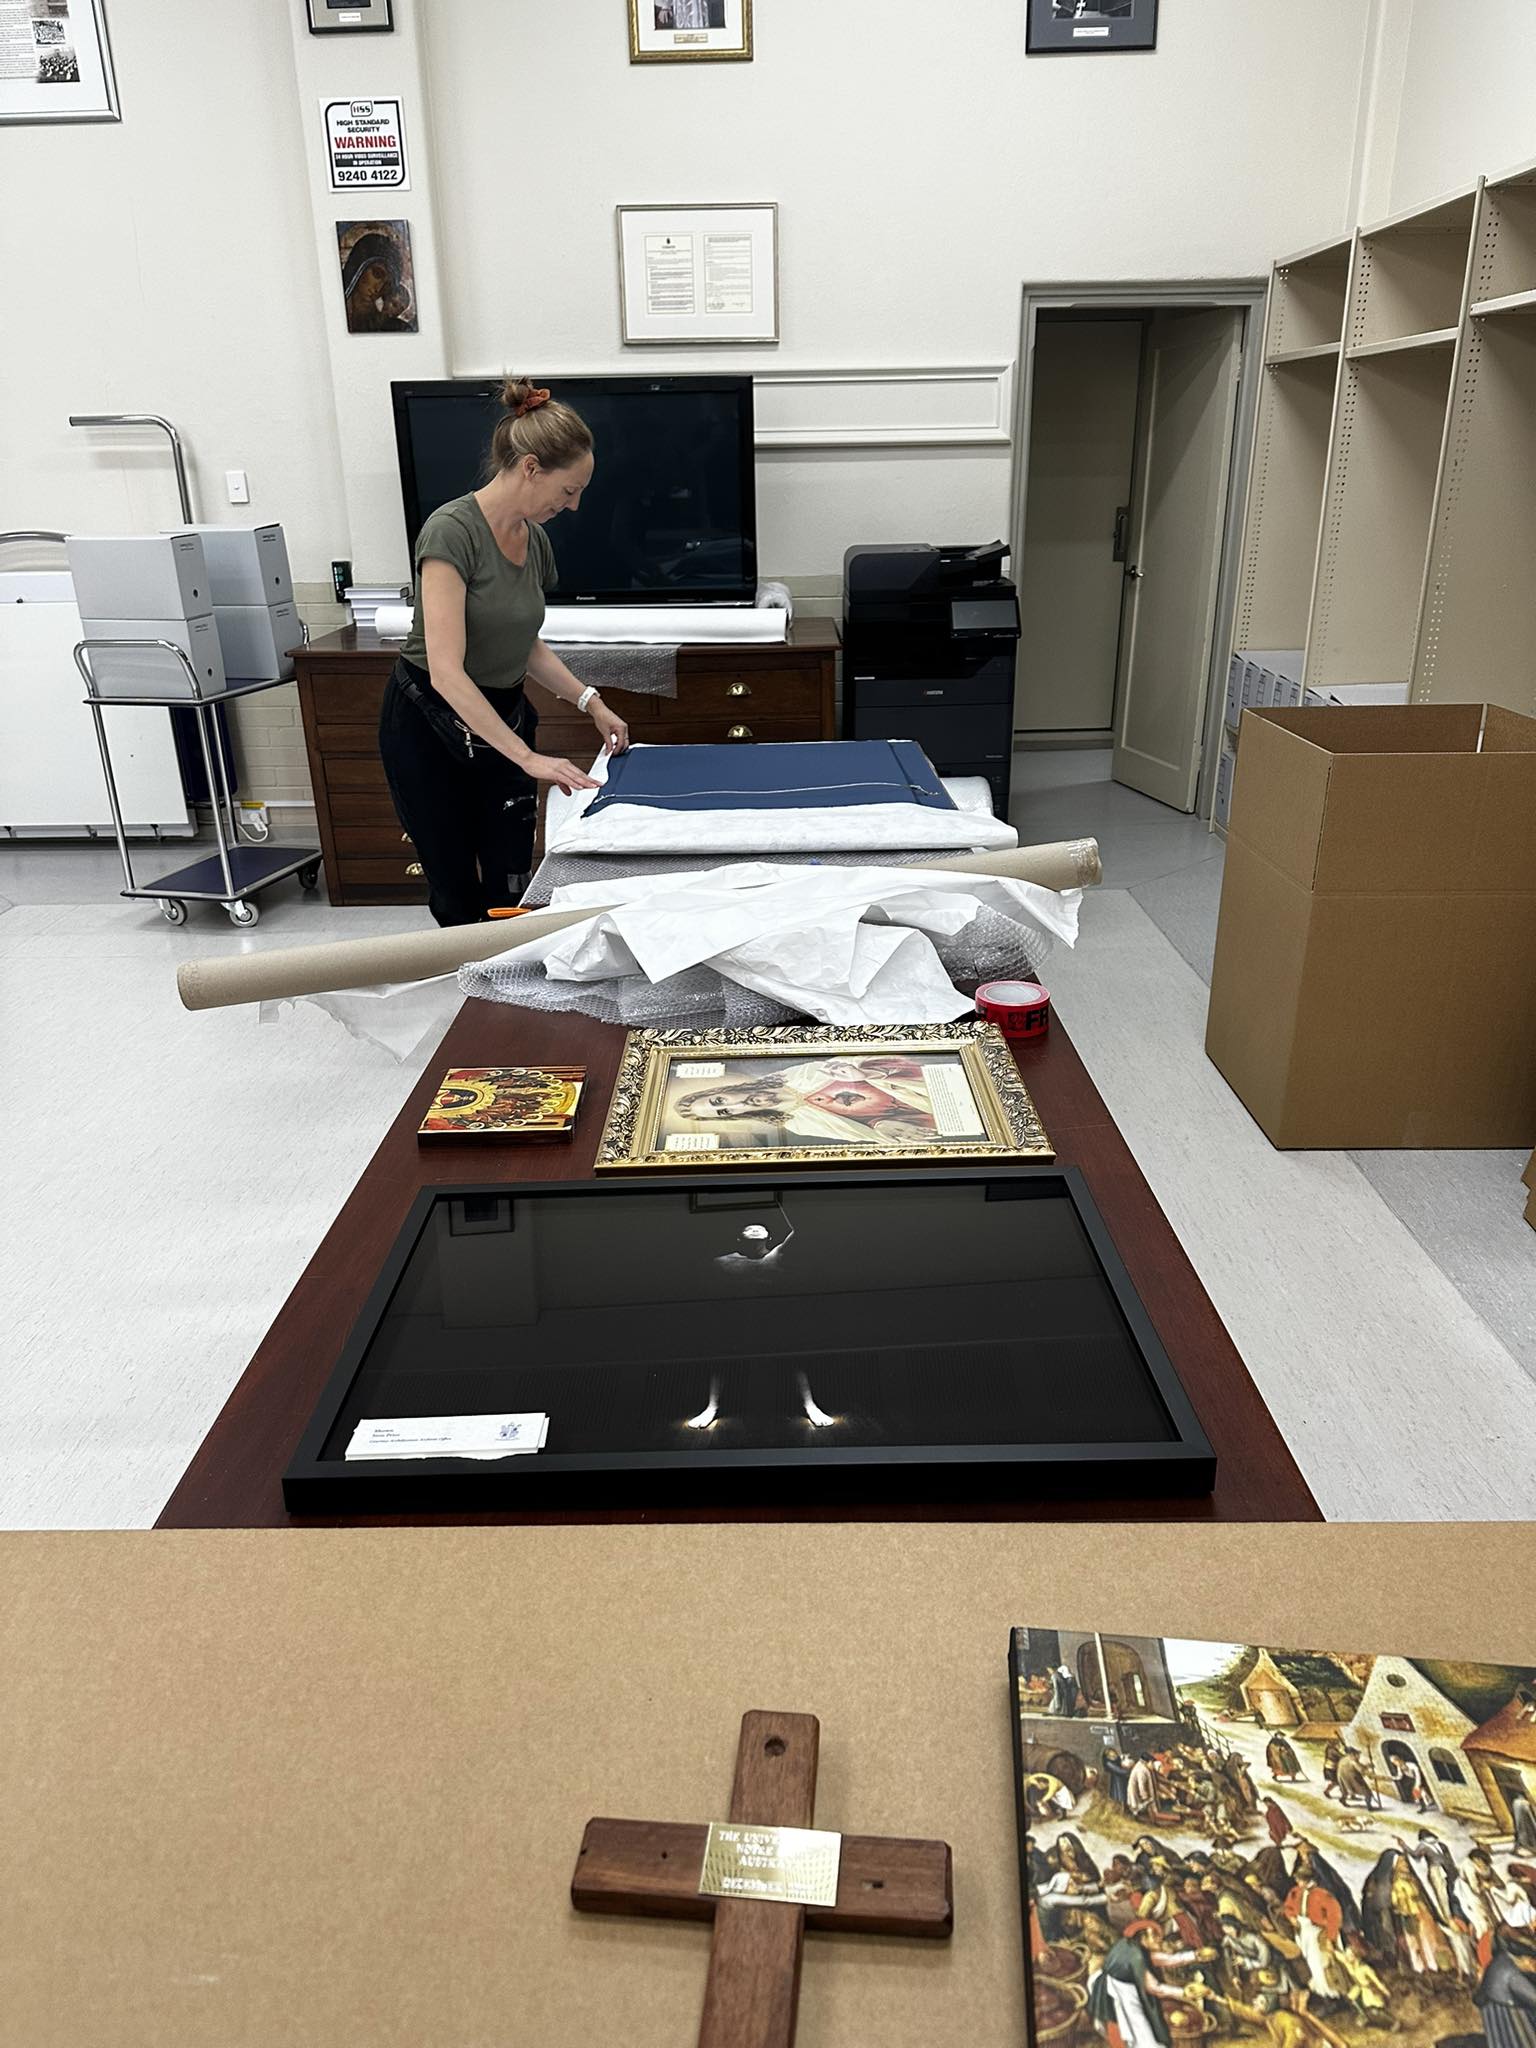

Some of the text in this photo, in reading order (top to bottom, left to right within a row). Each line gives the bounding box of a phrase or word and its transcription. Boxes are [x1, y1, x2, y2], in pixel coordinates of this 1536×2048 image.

[335, 136, 397, 149] WARNING
[338, 169, 398, 181] 9240 4122
